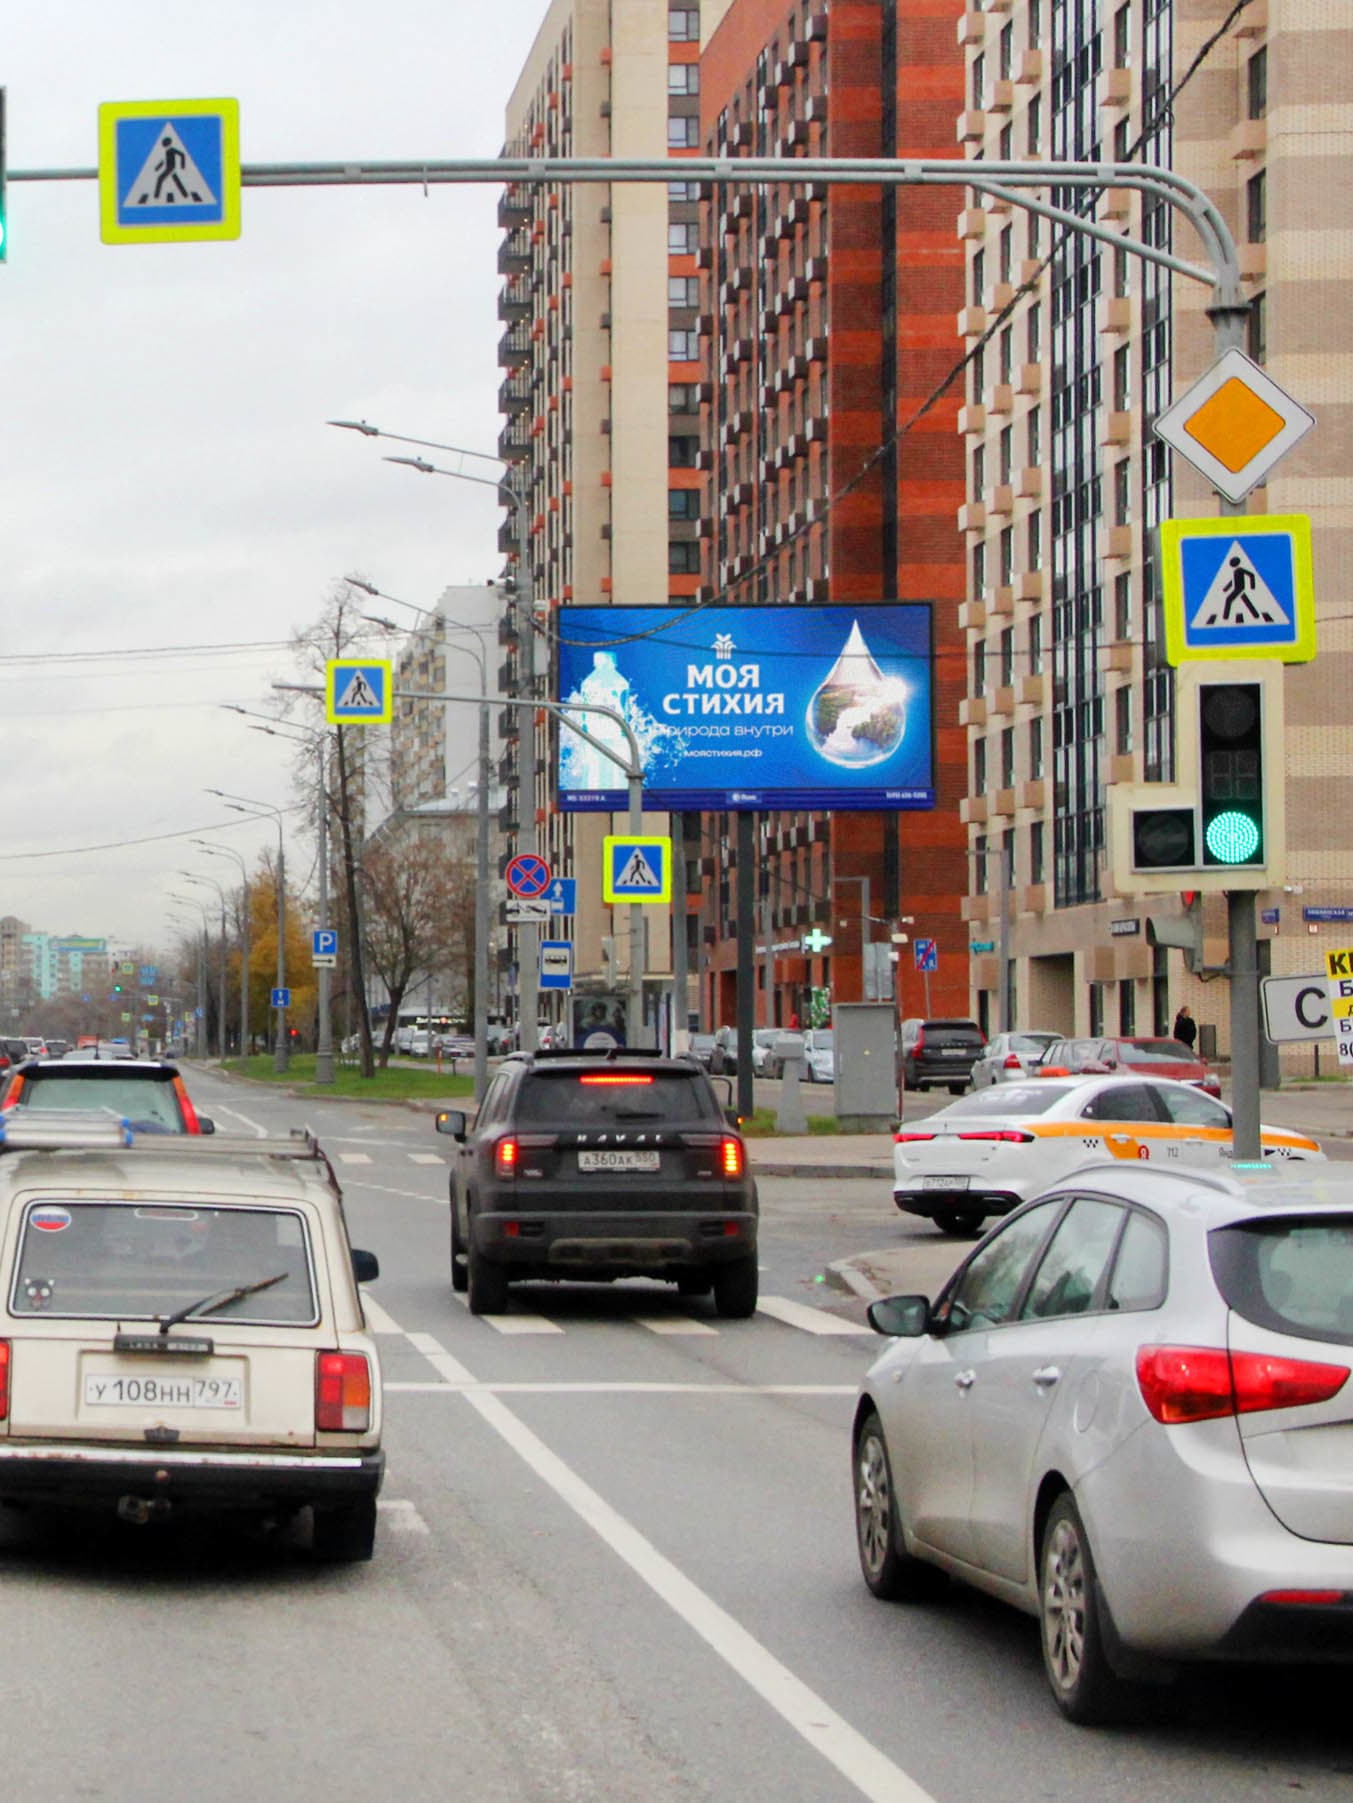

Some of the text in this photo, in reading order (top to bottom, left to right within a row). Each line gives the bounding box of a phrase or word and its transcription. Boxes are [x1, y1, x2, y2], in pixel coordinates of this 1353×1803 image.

[687, 664, 760, 688] МОЯ
[662, 693, 785, 714] СТИХИЯ
[734, 725, 794, 739] внутри
